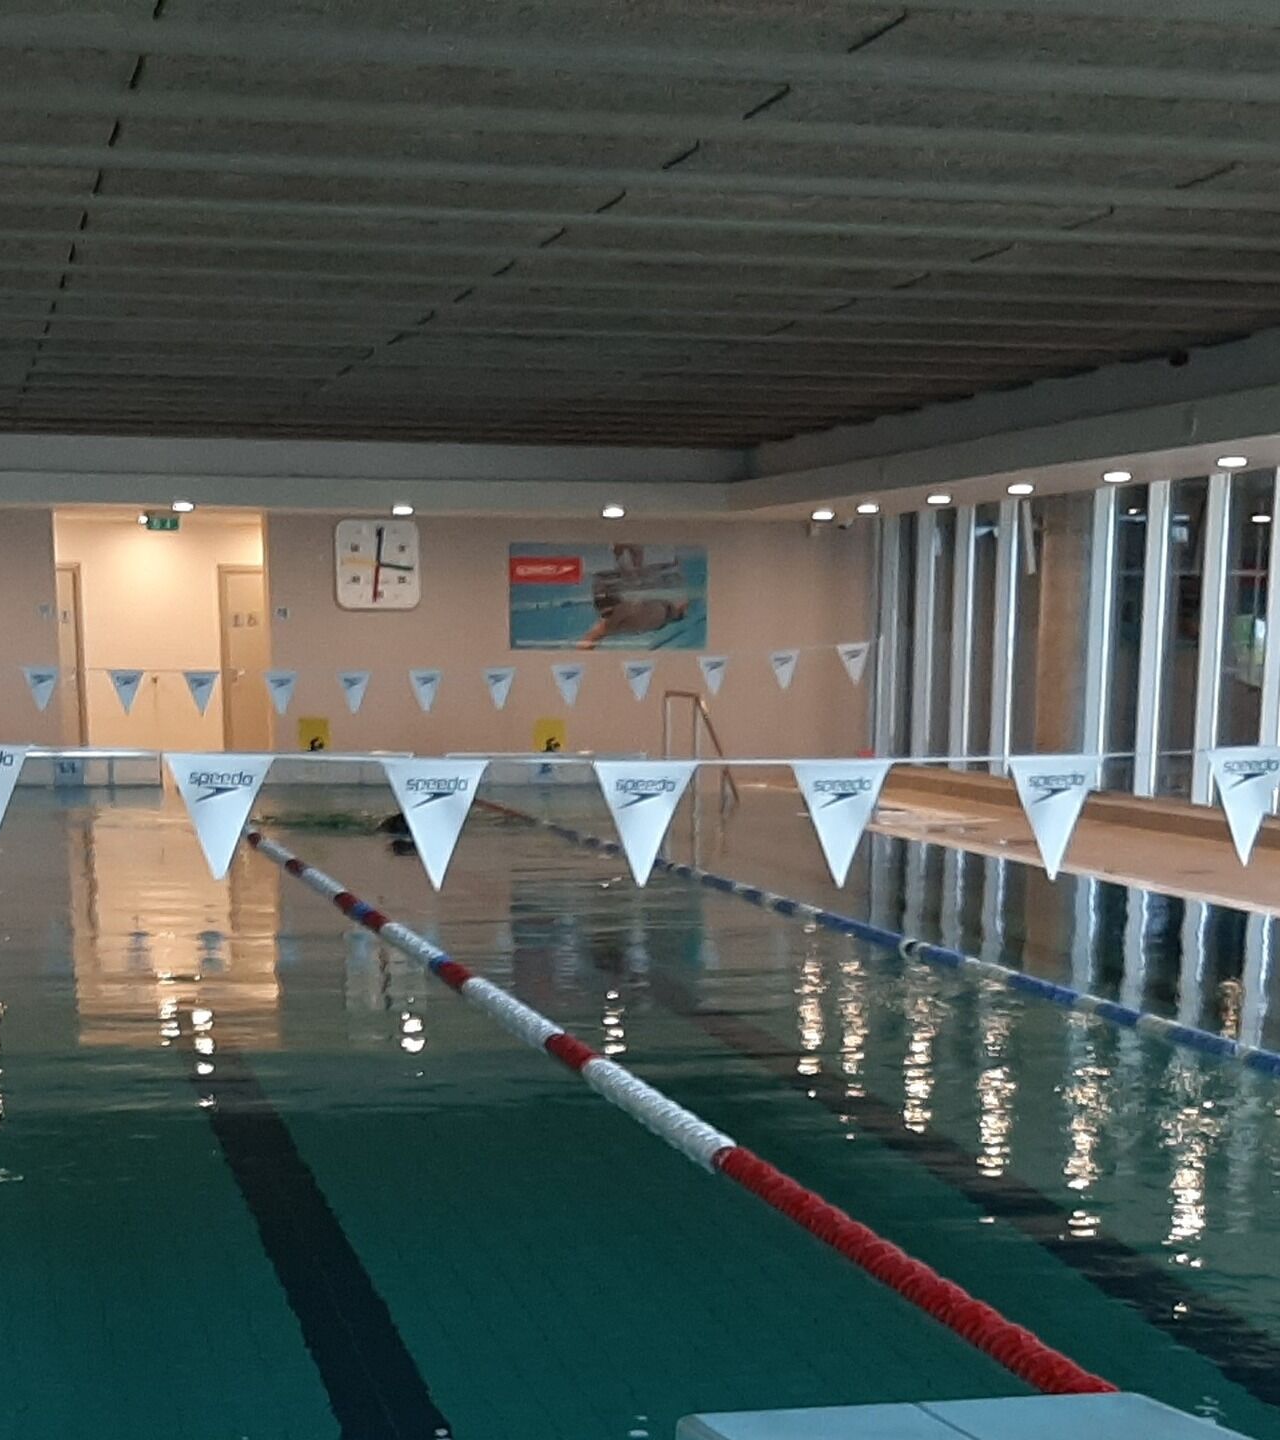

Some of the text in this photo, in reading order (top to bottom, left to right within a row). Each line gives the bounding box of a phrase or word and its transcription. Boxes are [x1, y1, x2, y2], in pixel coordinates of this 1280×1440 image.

[1223, 758, 1280, 773] speedo
[189, 771, 254, 786] speedo
[406, 776, 469, 791] speedo
[616, 777, 676, 792] speedo
[813, 777, 871, 791] speedo
[1029, 774, 1085, 788] speedo
